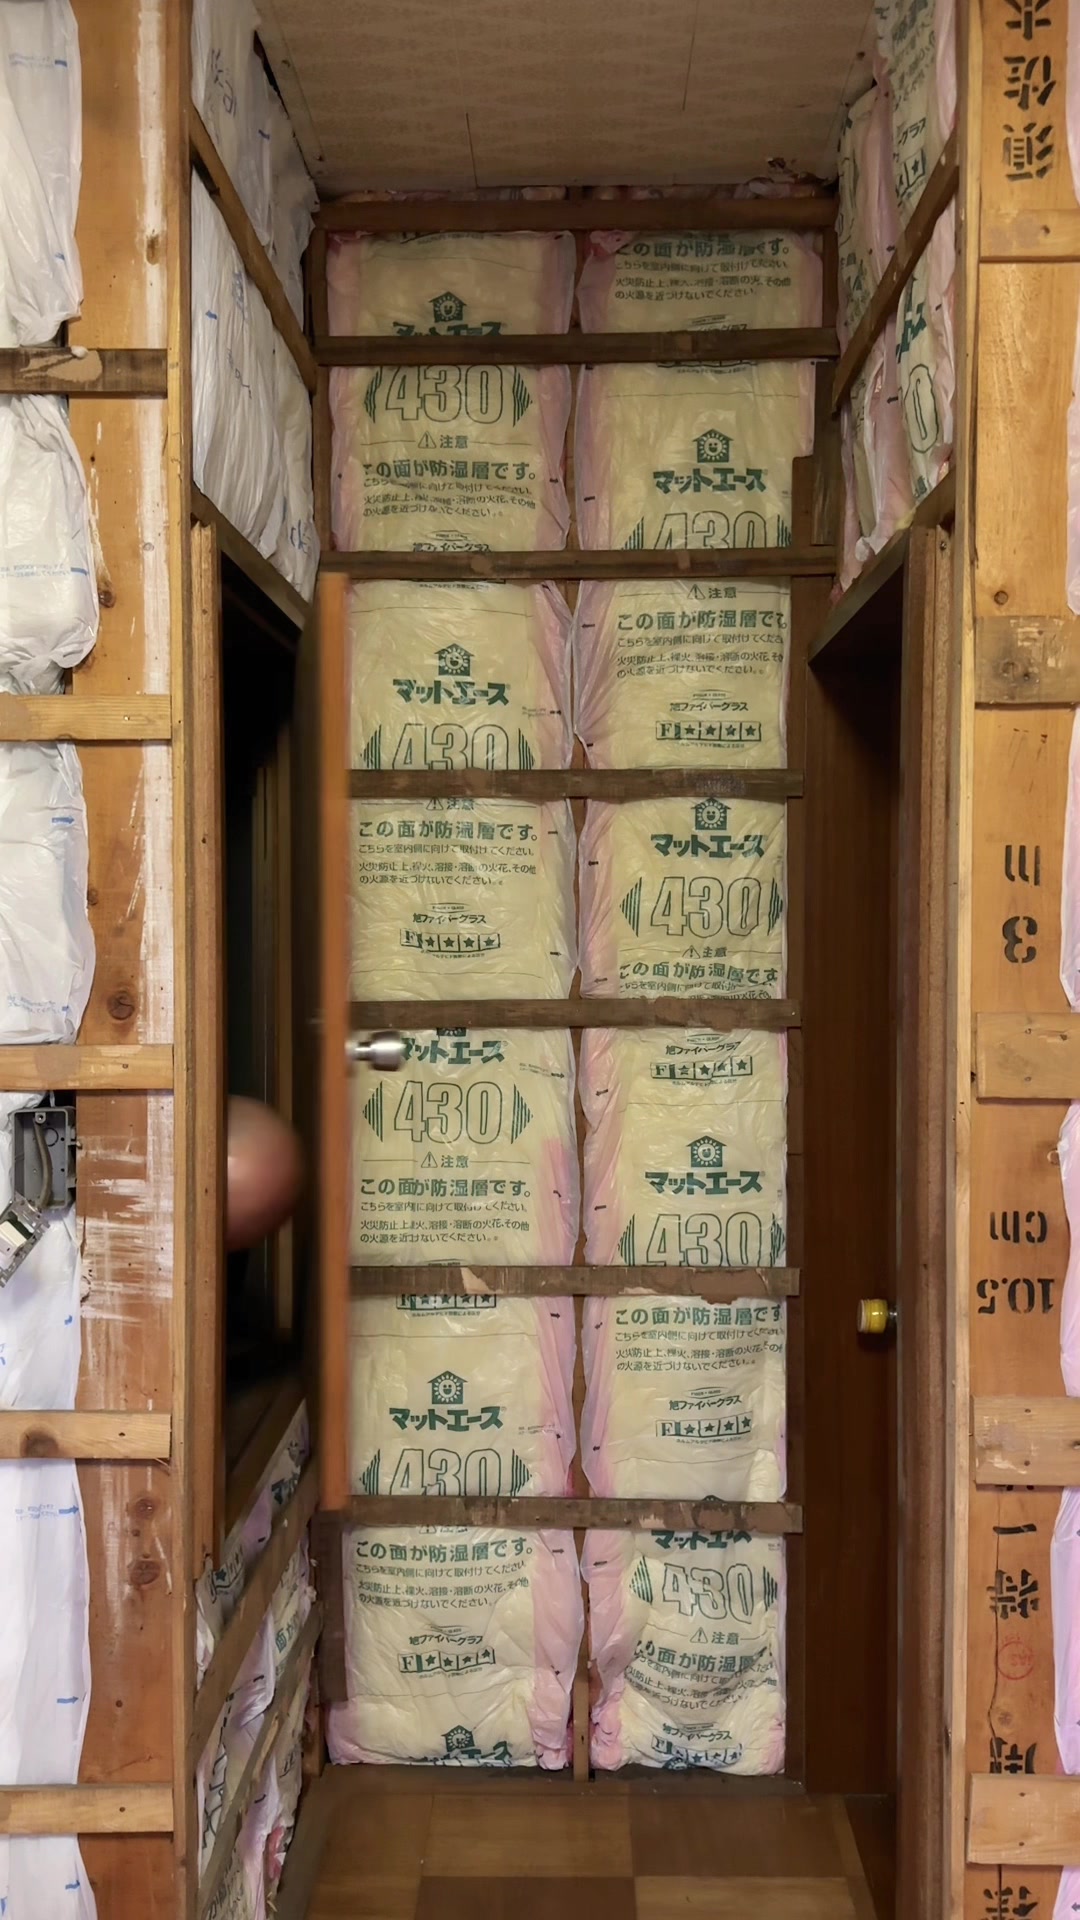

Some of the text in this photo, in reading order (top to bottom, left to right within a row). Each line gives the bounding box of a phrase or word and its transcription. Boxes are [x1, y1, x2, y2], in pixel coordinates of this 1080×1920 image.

[385, 364, 504, 424] 430
[440, 435, 469, 449] 注意
[653, 468, 766, 493] マットエース
[653, 510, 767, 550] 430
[708, 587, 737, 599] 注意
[392, 679, 510, 705] マットエース
[391, 722, 510, 770] 430
[651, 834, 767, 858] マットエース
[650, 877, 762, 938] 430
[1002, 916, 1039, 963] 3
[393, 1080, 503, 1144] 430
[440, 1155, 469, 1168] 注意
[360, 1177, 531, 1198] この面が防湿層です。
[645, 1171, 764, 1195] マットエース
[645, 1211, 763, 1267] 430
[988, 1211, 1048, 1243] cm
[976, 1278, 1055, 1314] 10.5
[388, 1406, 504, 1432] マットエース
[390, 1448, 502, 1496] 430
[355, 1537, 533, 1563] この面が防湿層です。
[662, 1563, 754, 1625] 430
[711, 1632, 740, 1645] 注意
